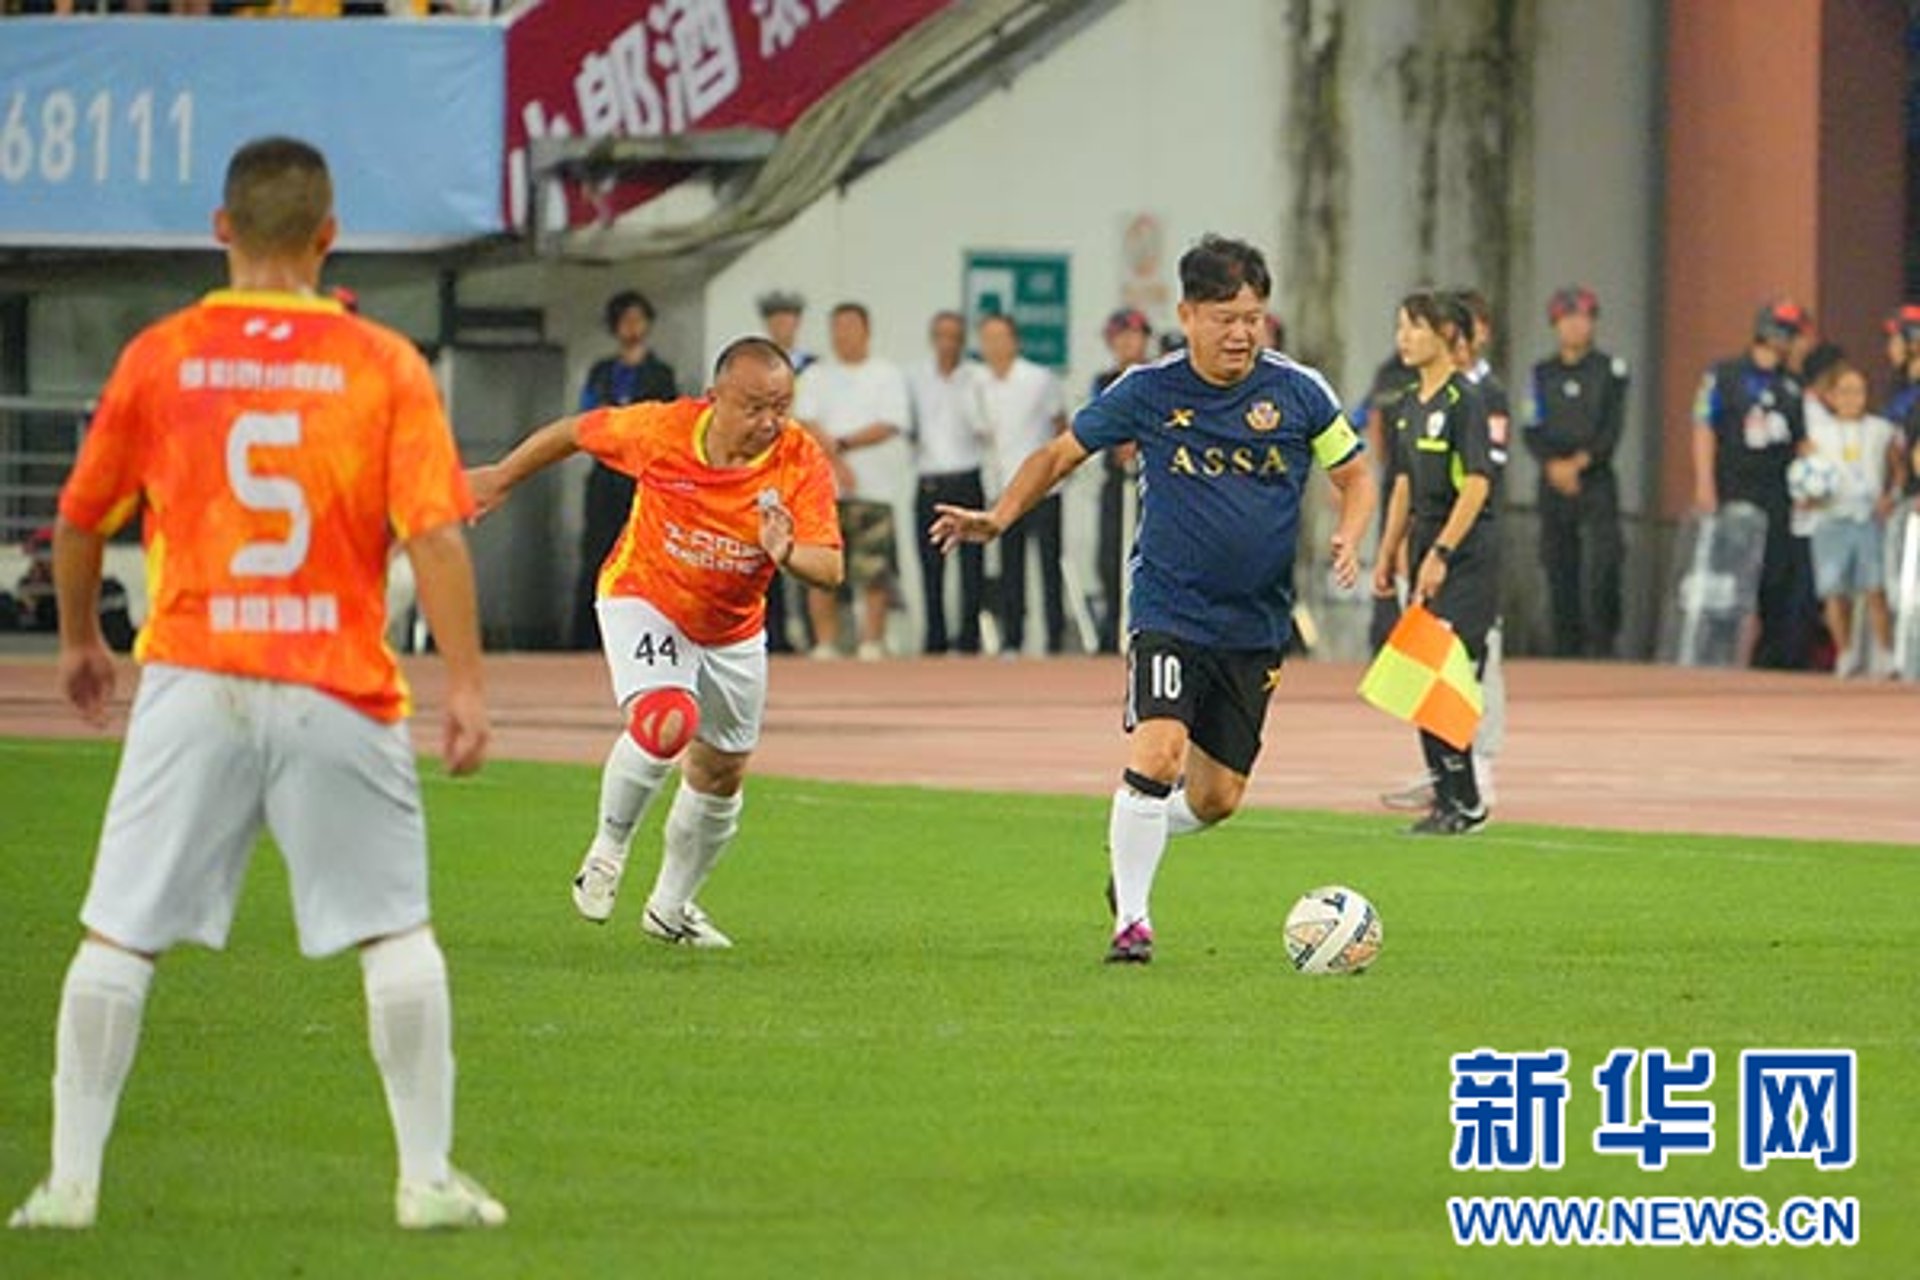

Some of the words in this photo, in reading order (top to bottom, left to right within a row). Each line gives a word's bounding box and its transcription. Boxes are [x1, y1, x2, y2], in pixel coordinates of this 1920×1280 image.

[0, 90, 194, 183] 68111
[1170, 446, 1288, 476] ASSA
[226, 411, 312, 577] 5
[635, 633, 679, 667] 44
[1151, 655, 1182, 699] 10
